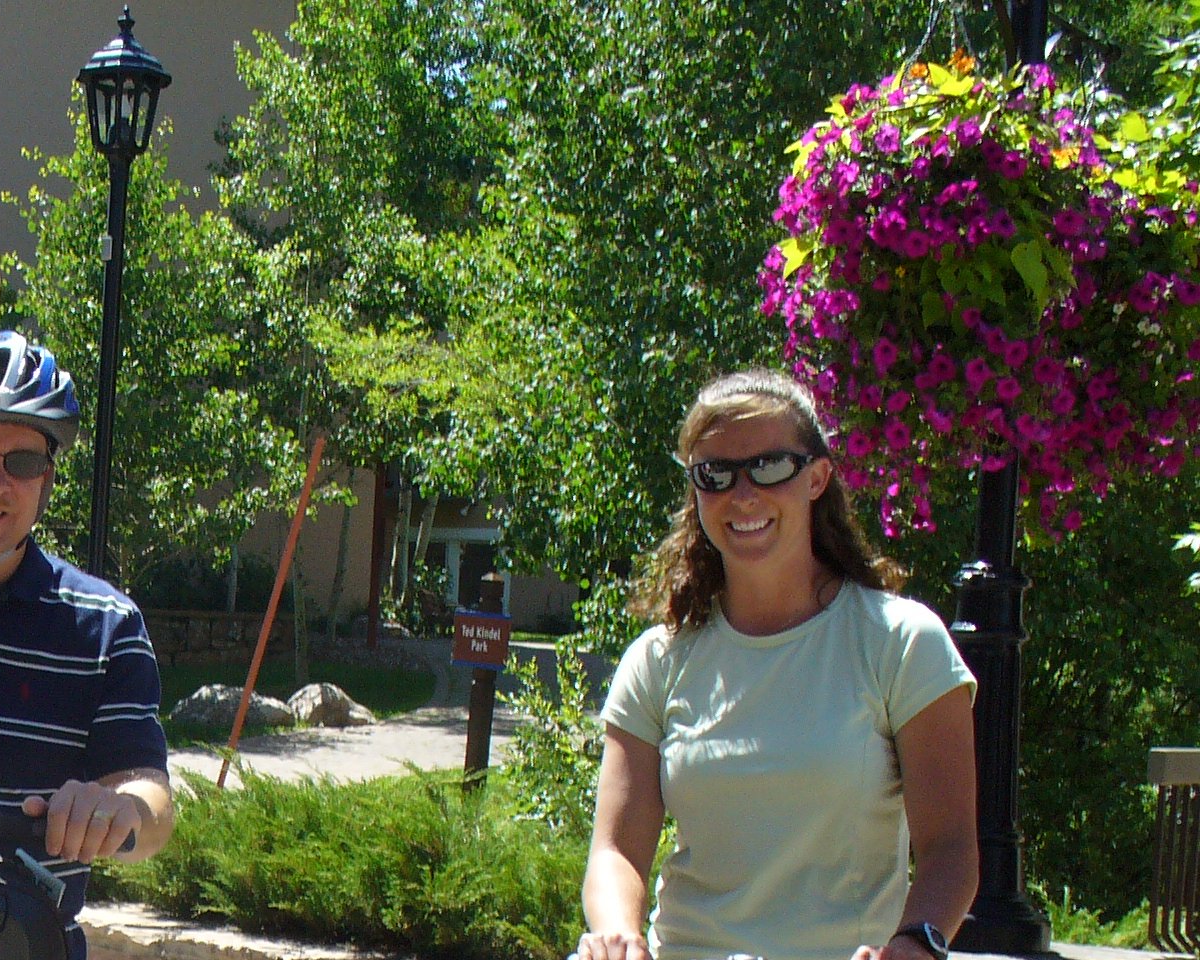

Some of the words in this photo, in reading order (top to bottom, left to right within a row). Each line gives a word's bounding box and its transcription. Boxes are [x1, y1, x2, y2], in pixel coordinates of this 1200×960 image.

[462, 624, 475, 638] Ted
[476, 626, 501, 641] Kindel
[471, 639, 488, 653] Park
